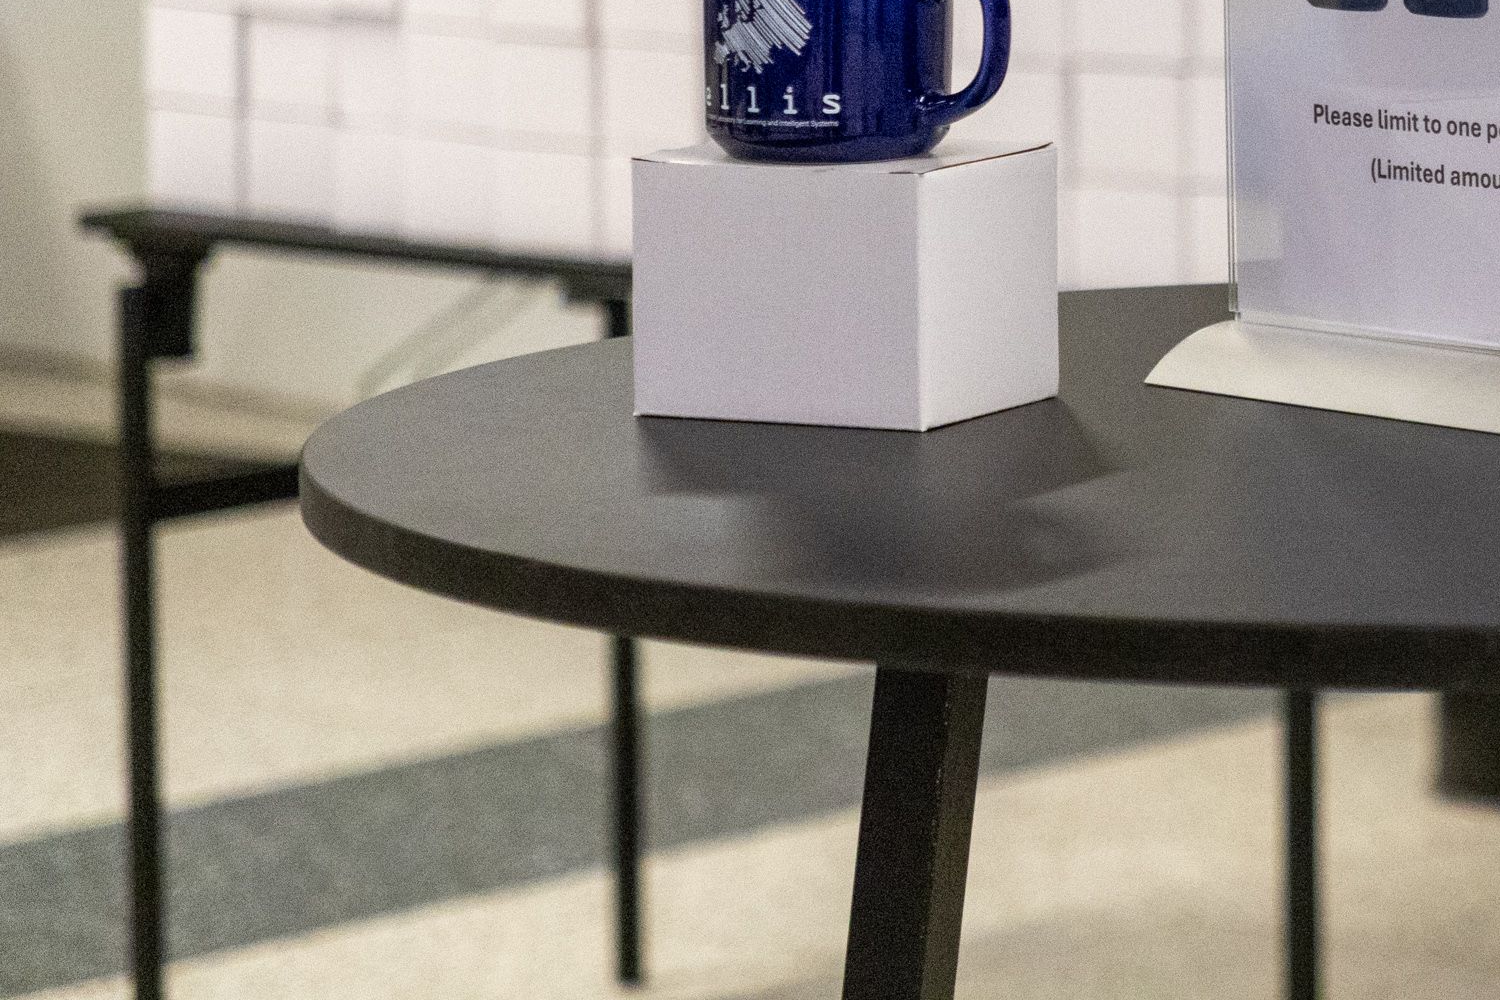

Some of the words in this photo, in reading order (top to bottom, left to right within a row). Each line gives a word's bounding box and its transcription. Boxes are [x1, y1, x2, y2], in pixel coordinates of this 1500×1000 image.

[1313, 103, 1374, 129] Please
[1377, 108, 1419, 133] limit
[1422, 115, 1442, 135] to
[1446, 119, 1482, 138] one
[1370, 157, 1445, 185] (Limited
